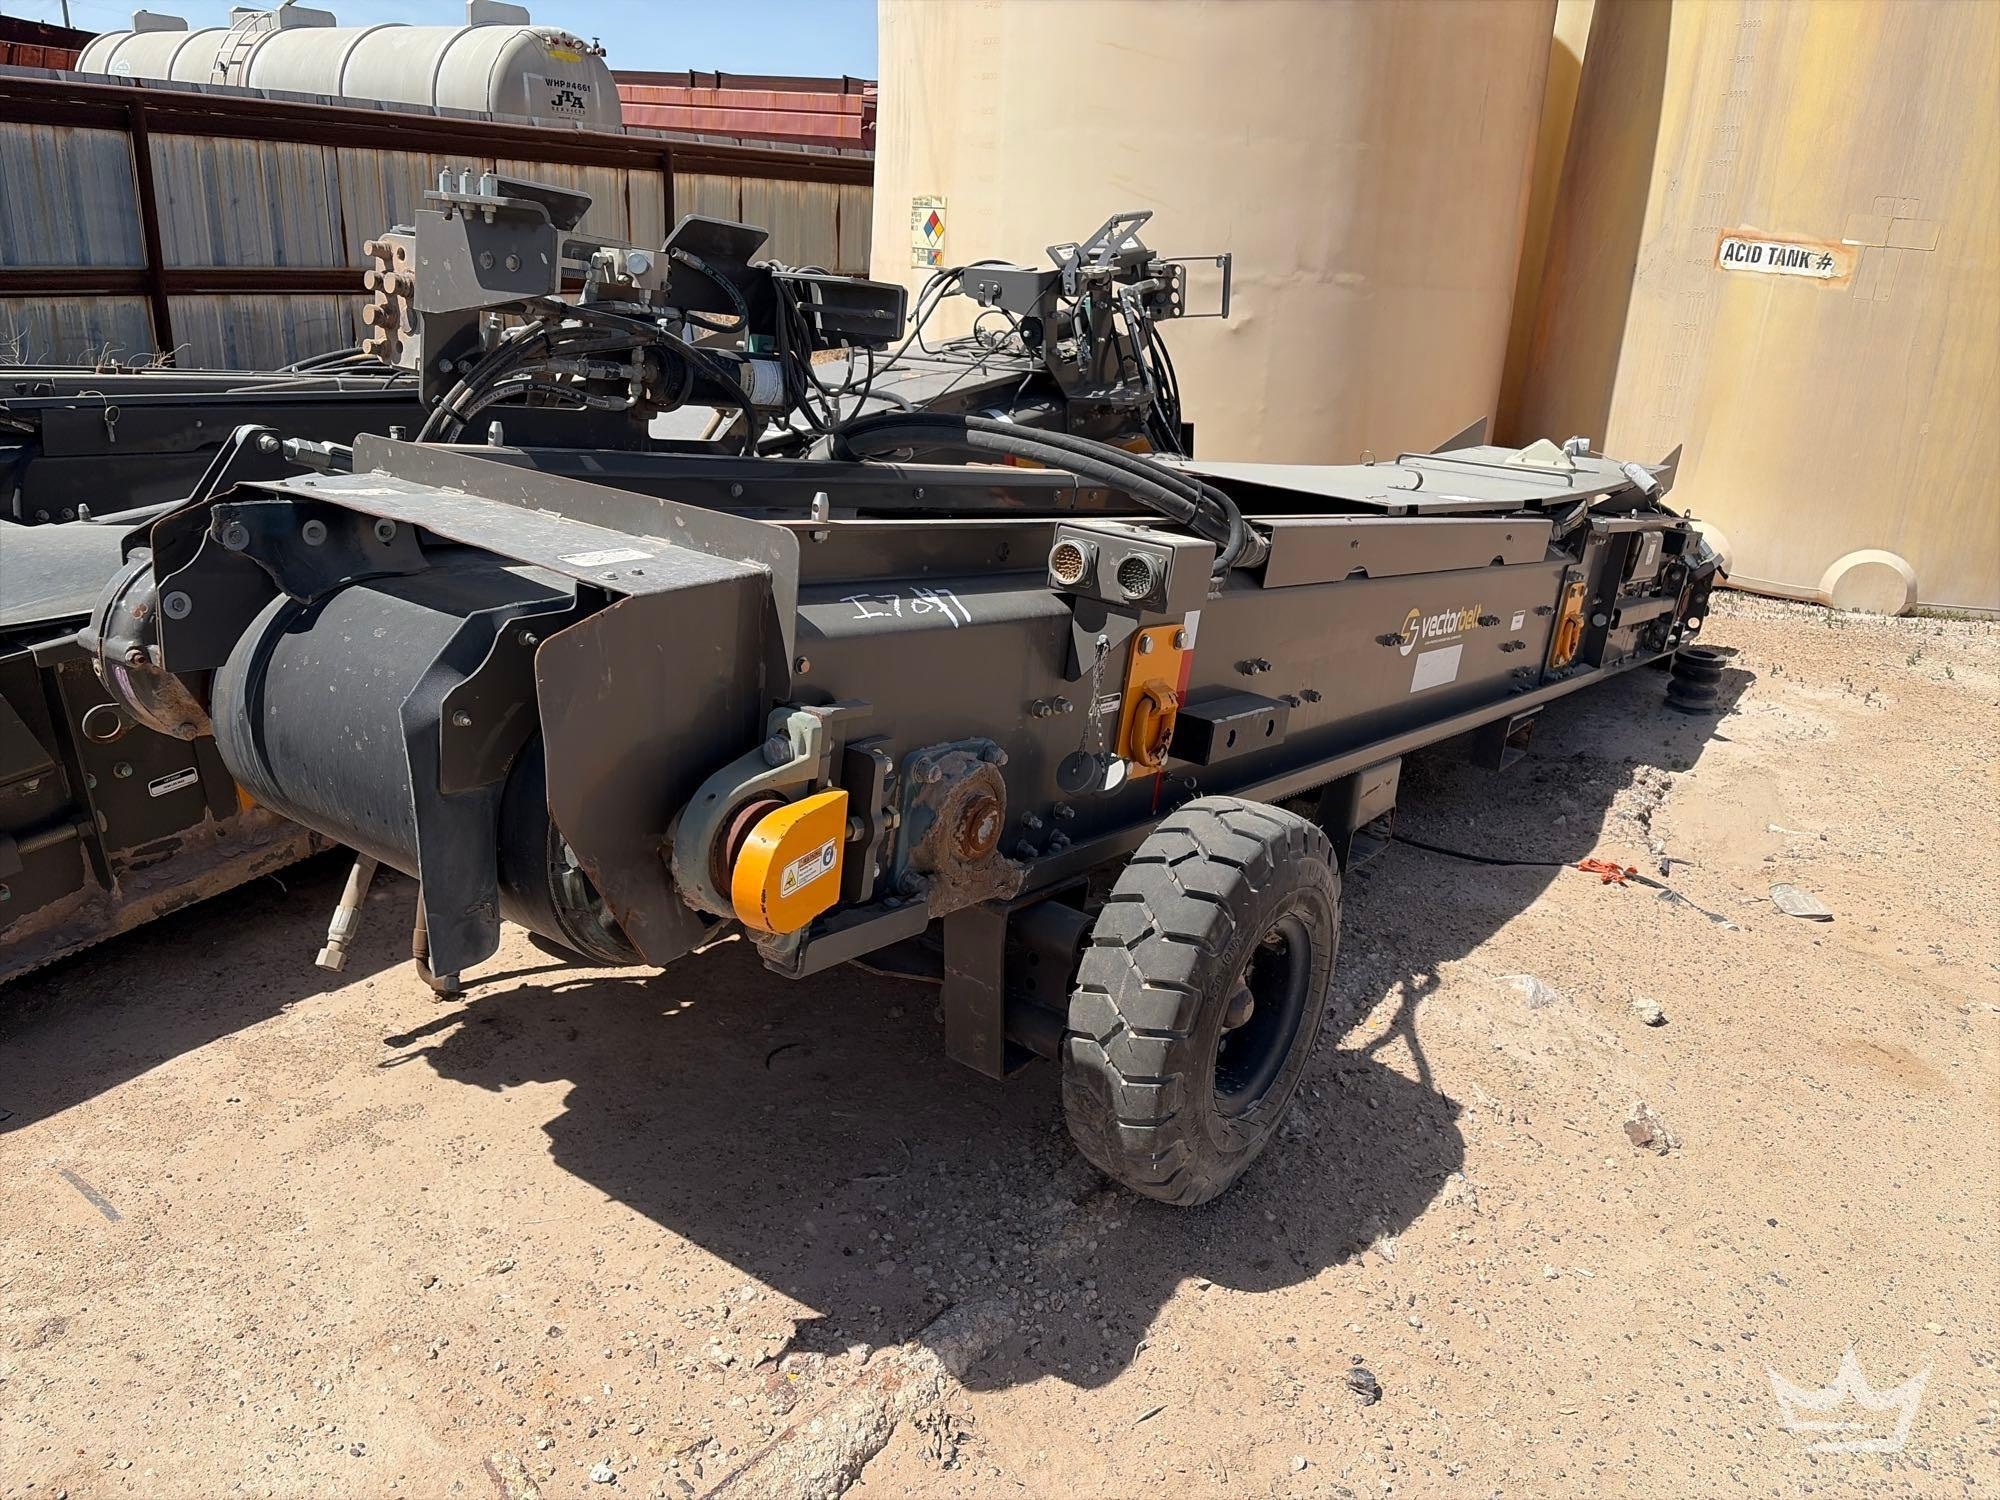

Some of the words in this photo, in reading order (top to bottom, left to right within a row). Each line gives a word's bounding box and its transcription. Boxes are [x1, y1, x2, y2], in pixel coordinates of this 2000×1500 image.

[545, 78, 591, 92] WHP#4661
[551, 90, 585, 109] JTA
[1724, 242, 1763, 263] ACID
[1768, 247, 1812, 269] TANK
[1815, 252, 1833, 271] #
